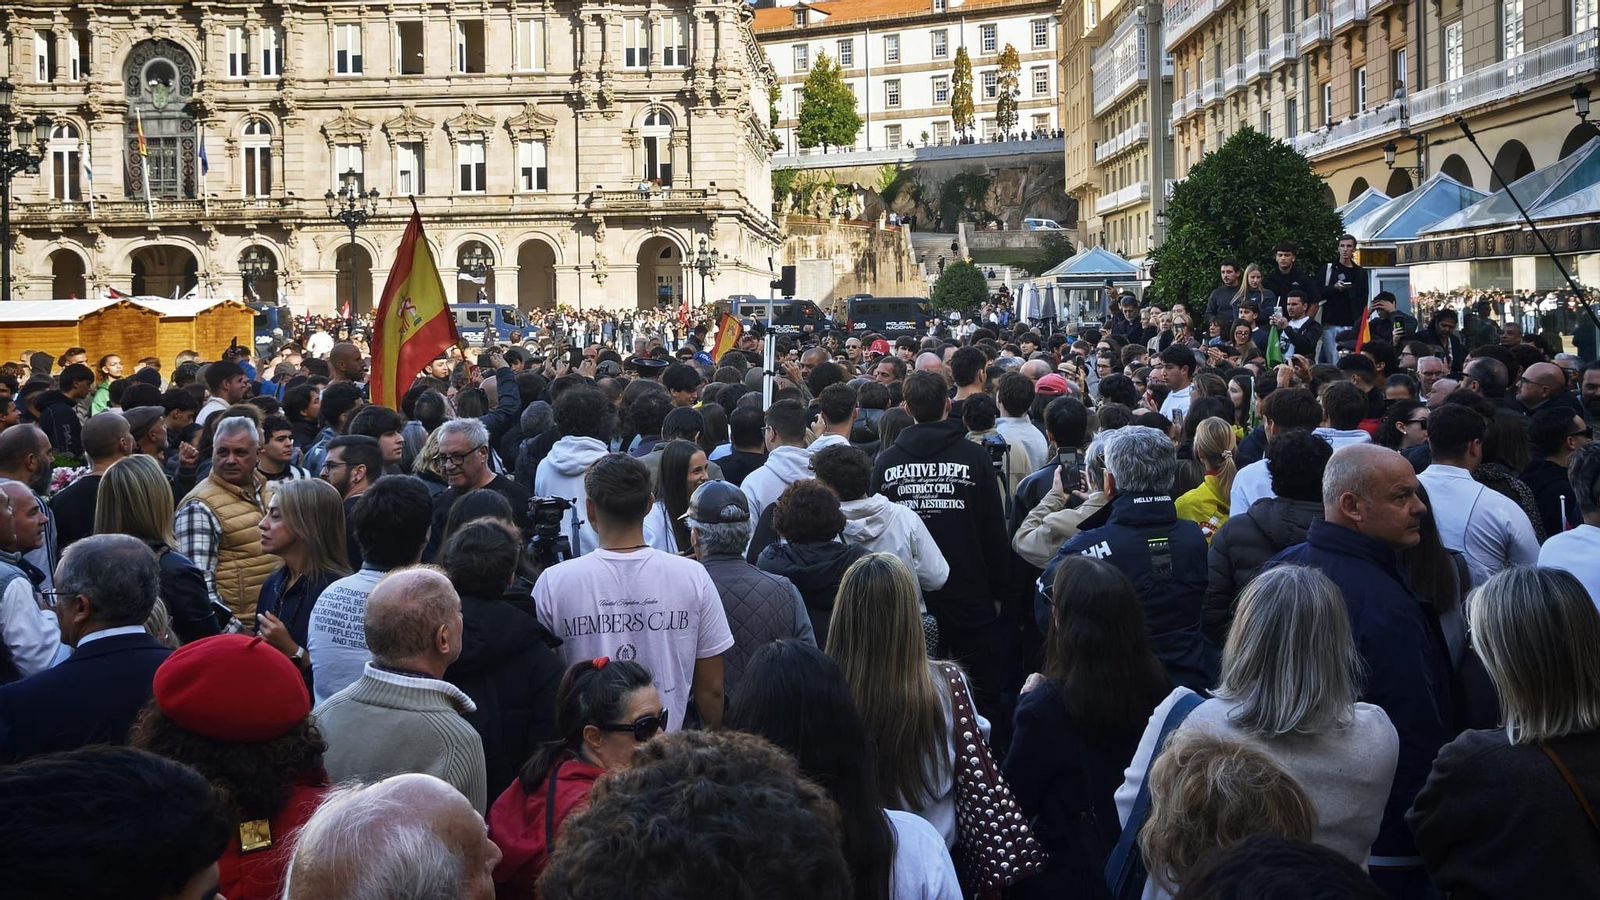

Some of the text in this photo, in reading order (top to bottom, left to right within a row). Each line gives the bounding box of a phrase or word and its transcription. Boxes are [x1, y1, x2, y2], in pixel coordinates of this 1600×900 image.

[884, 462, 971, 482] CREATIVE DEPT.
[897, 484, 934, 496] (DISTRICT
[920, 500, 965, 509] AESTHETICS
[1133, 496, 1153, 504] HELLY
[320, 608, 348, 621] DEFINING
[342, 605, 357, 614] HAS
[563, 610, 689, 637] MEMBERS CLUB
[328, 626, 364, 640] REFLECTS
[332, 636, 346, 645] AND
